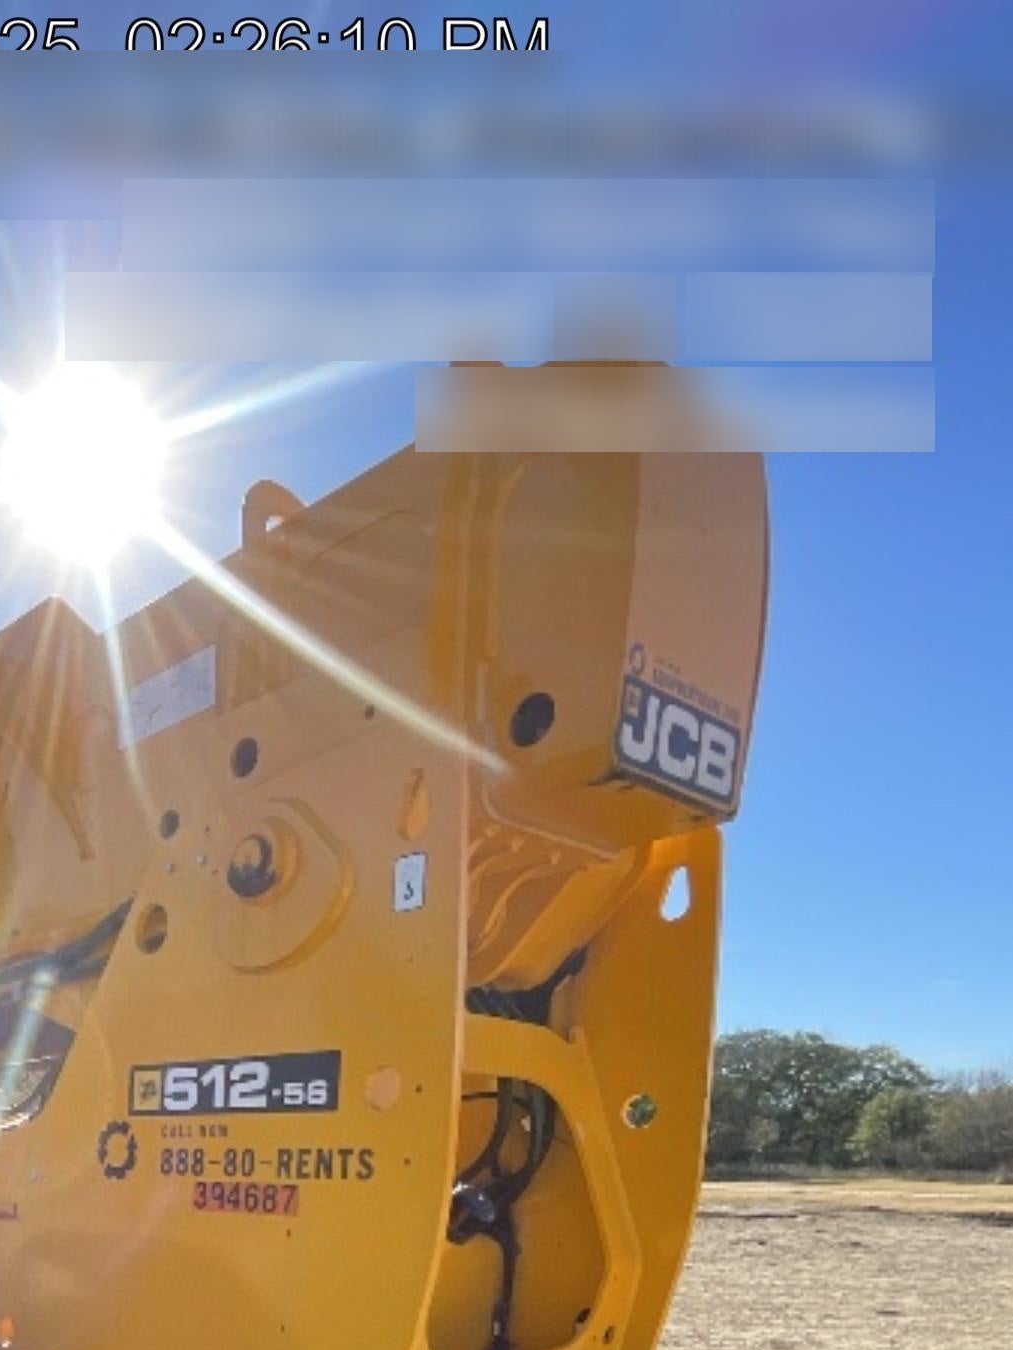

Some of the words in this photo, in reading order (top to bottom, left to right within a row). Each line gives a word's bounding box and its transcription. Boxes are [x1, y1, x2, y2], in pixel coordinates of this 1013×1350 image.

[620, 695, 736, 796] JCB
[160, 1147, 375, 1181] 888-80-RENTS
[192, 1180, 299, 1214] 394687
